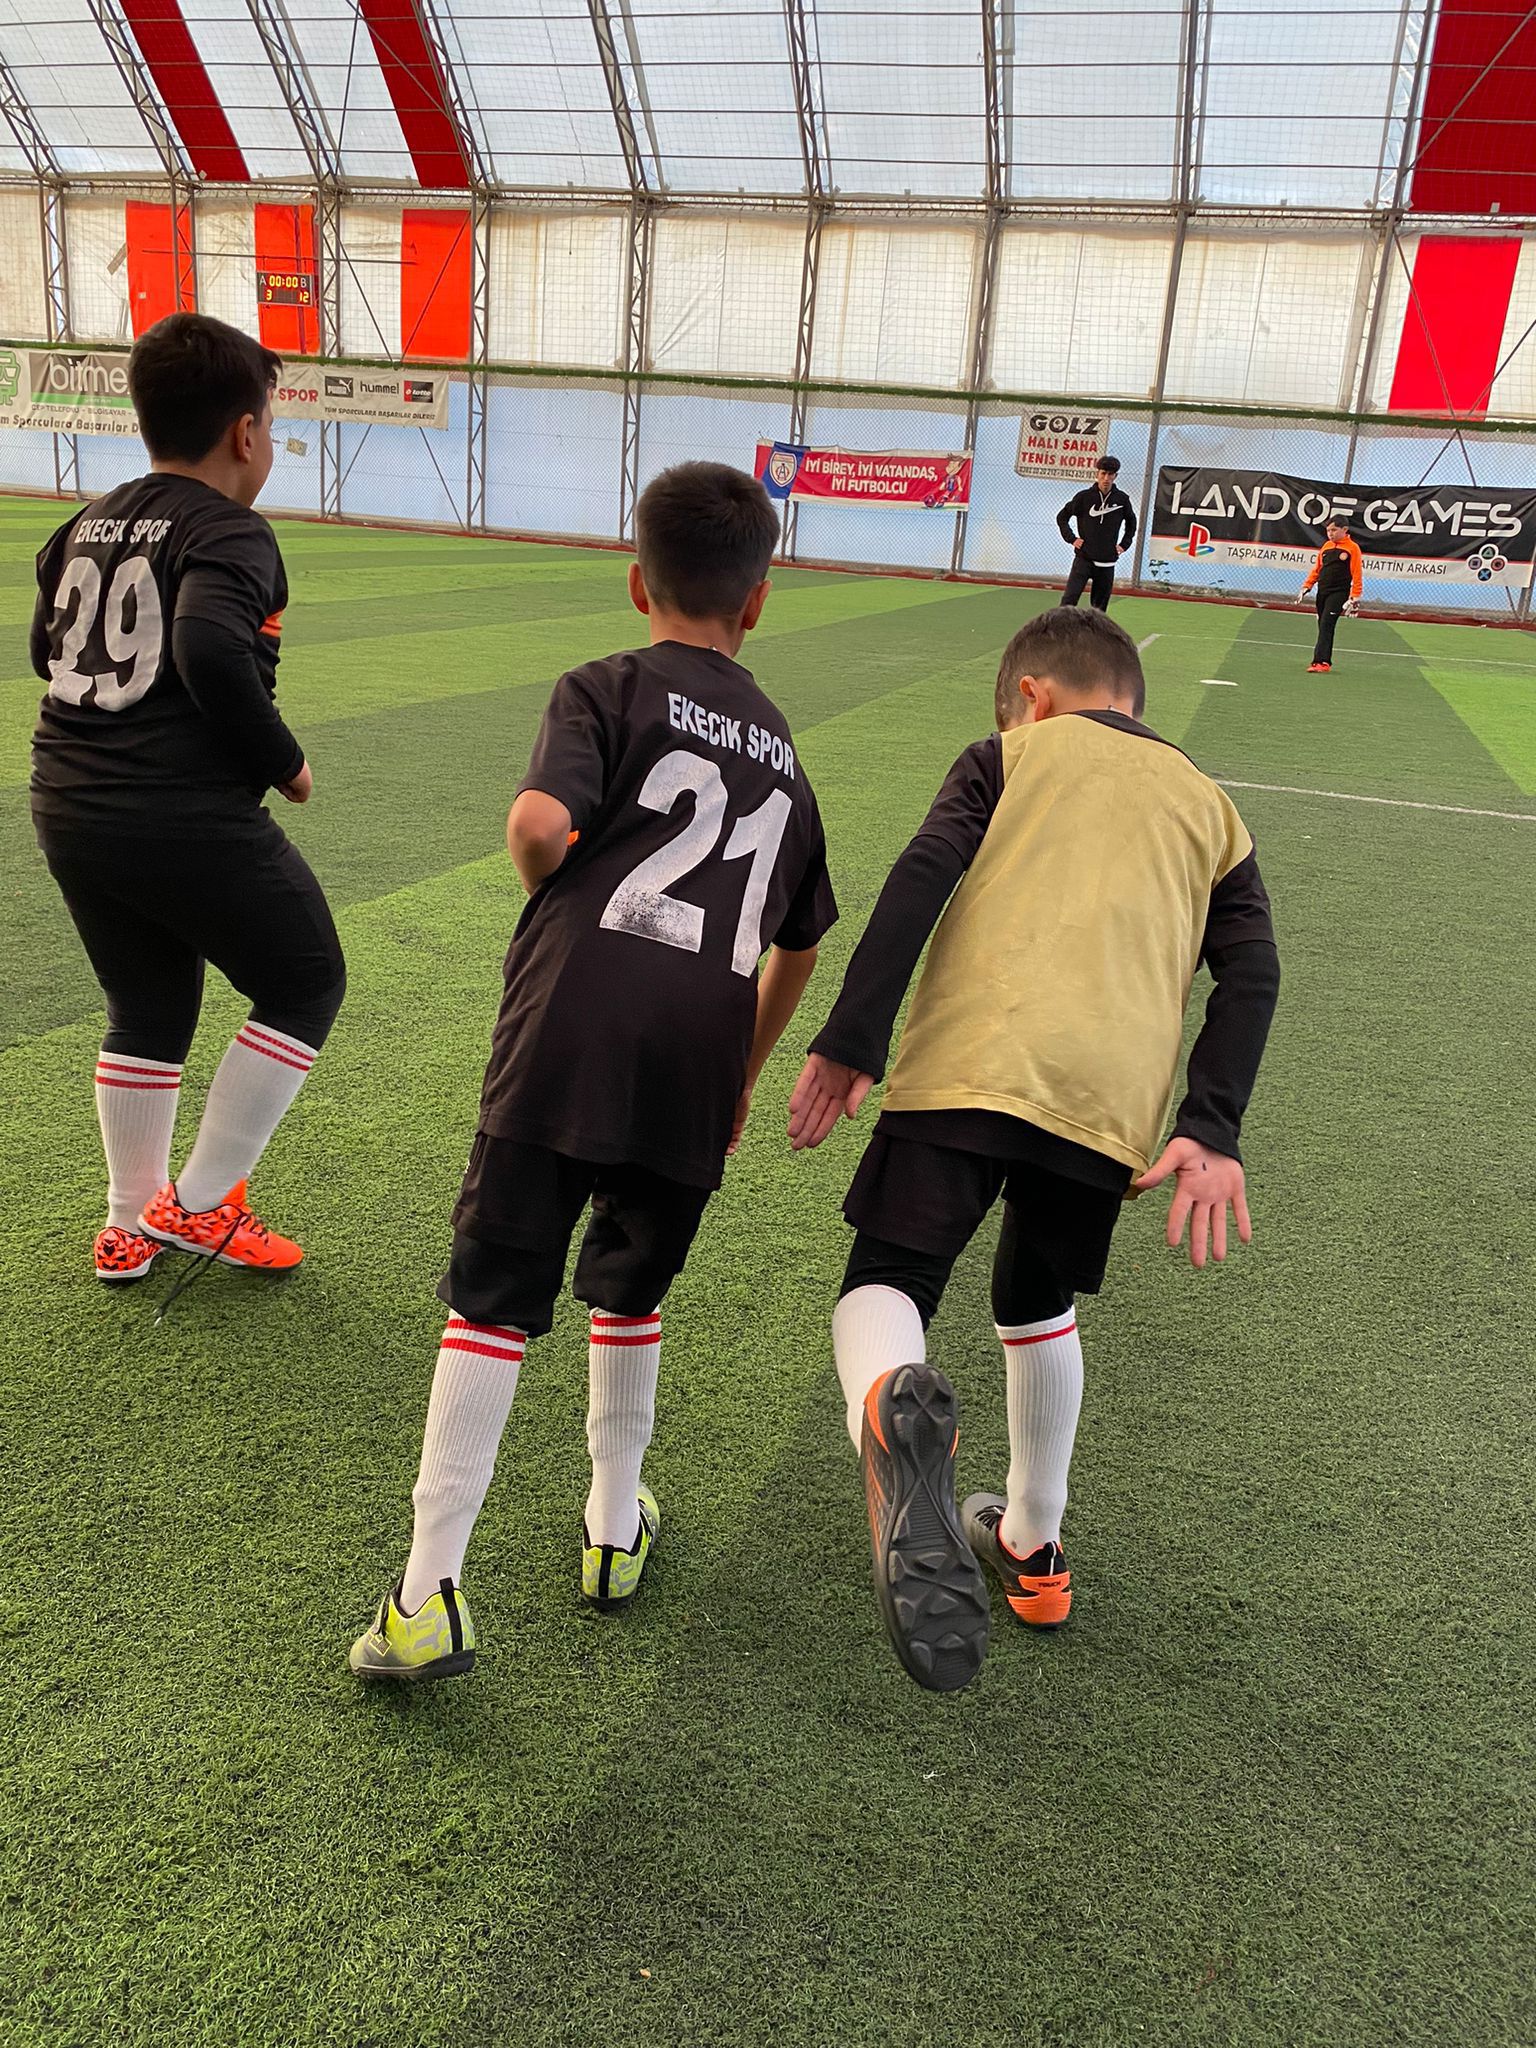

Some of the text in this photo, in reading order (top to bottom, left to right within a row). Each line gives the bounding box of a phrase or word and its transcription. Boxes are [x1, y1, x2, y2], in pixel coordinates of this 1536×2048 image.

[259, 275, 307, 288] A 00:00 B
[266, 289, 309, 303] 3 12
[49, 357, 131, 394] bitme
[278, 388, 319, 402] SPOR
[360, 381, 400, 394] hummel
[13, 415, 73, 429] Sporculara
[76, 419, 128, 433] Başarılar
[1028, 436, 1098, 452] HALI SAHA
[805, 458, 820, 472] İYİ
[857, 461, 873, 475] İYİ
[1021, 451, 1056, 465] TENİS
[831, 476, 908, 494] İYİ FUTBOLCU
[1171, 481, 1290, 521] LAND
[1363, 500, 1522, 538] GAMES
[1227, 547, 1277, 560] TAŞPAZAR
[1280, 552, 1306, 564] MAH.
[1361, 559, 1404, 573] AHATTİN
[1407, 563, 1447, 575] ARKASI
[48, 556, 163, 712] 29
[746, 723, 795, 780] SPOR
[599, 749, 792, 978] 21
